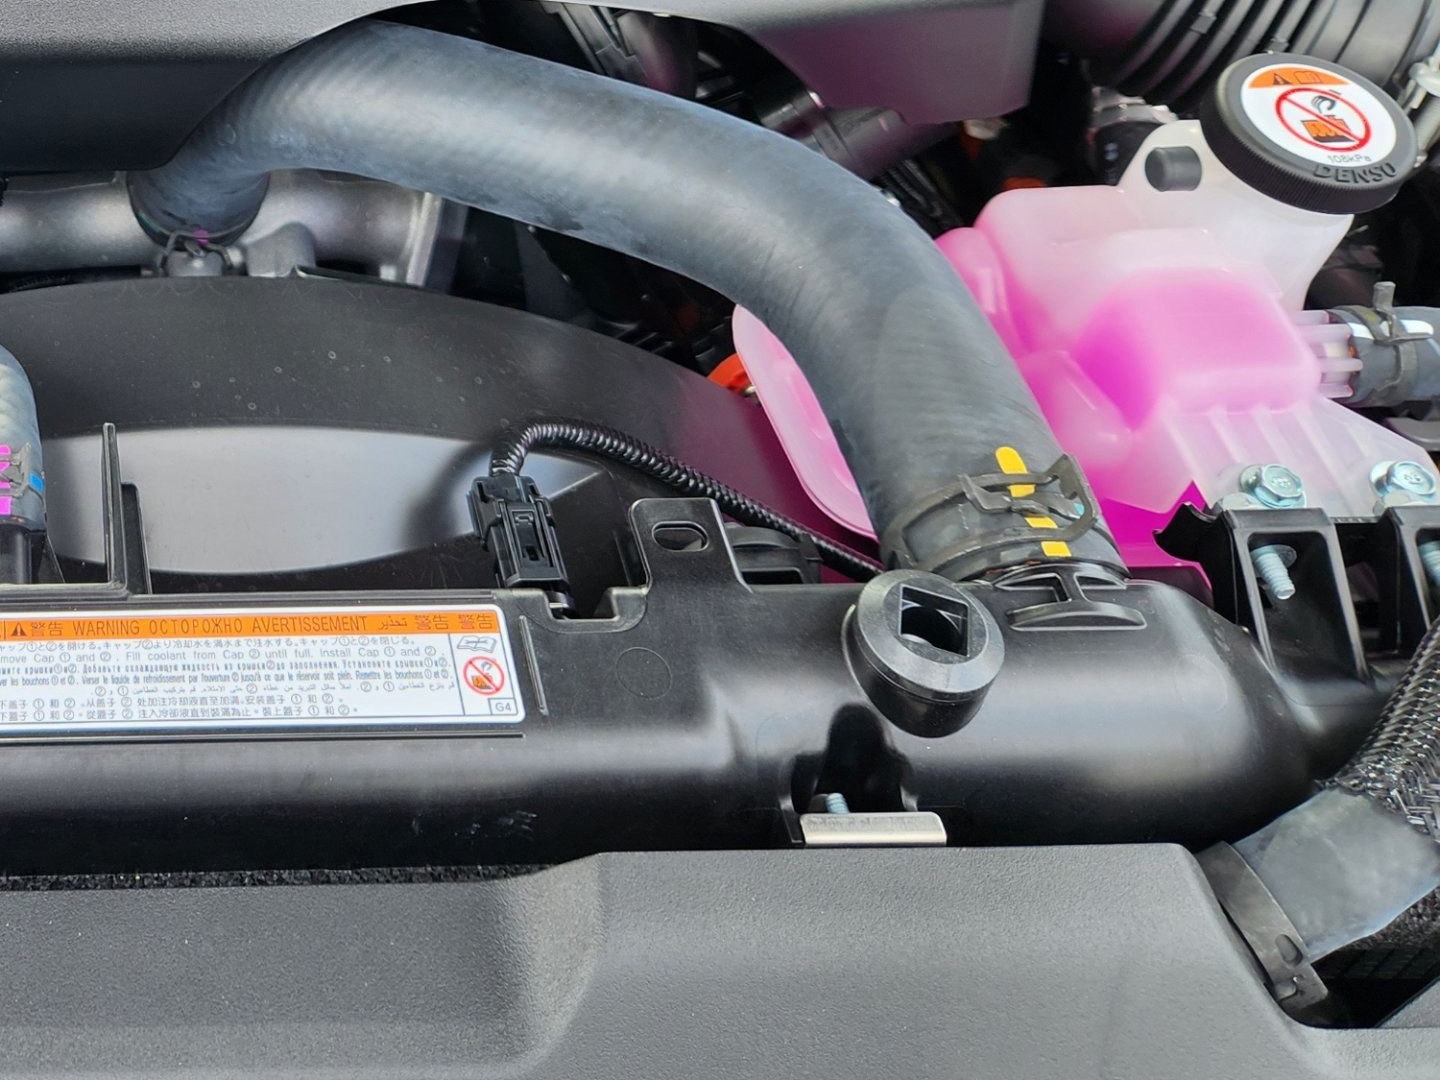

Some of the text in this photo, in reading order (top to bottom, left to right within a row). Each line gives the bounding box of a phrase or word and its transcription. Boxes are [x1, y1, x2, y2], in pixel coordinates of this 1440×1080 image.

[1328, 155, 1372, 163] 108kPa
[1313, 162, 1397, 184] DENSO
[32, 622, 64, 637] 警告
[73, 620, 140, 637] WARNING
[149, 618, 243, 635] ОСТОРОЖНО
[252, 616, 368, 633] AVERTISSEMENT
[414, 614, 449, 631] 警告
[458, 614, 493, 630] 警告
[34, 653, 55, 664] Cap
[76, 652, 96, 662] and
[126, 651, 141, 660] Fill
[148, 651, 186, 661] coolant
[194, 650, 216, 660] from
[222, 649, 245, 660] Cap
[265, 649, 288, 659] until
[295, 648, 314, 658] full.
[320, 648, 351, 658] Install
[358, 648, 380, 659] Cap
[401, 646, 421, 657] and
[22, 676, 50, 686] bouchons
[394, 670, 423, 680] bouchons
[496, 702, 513, 713] G4
